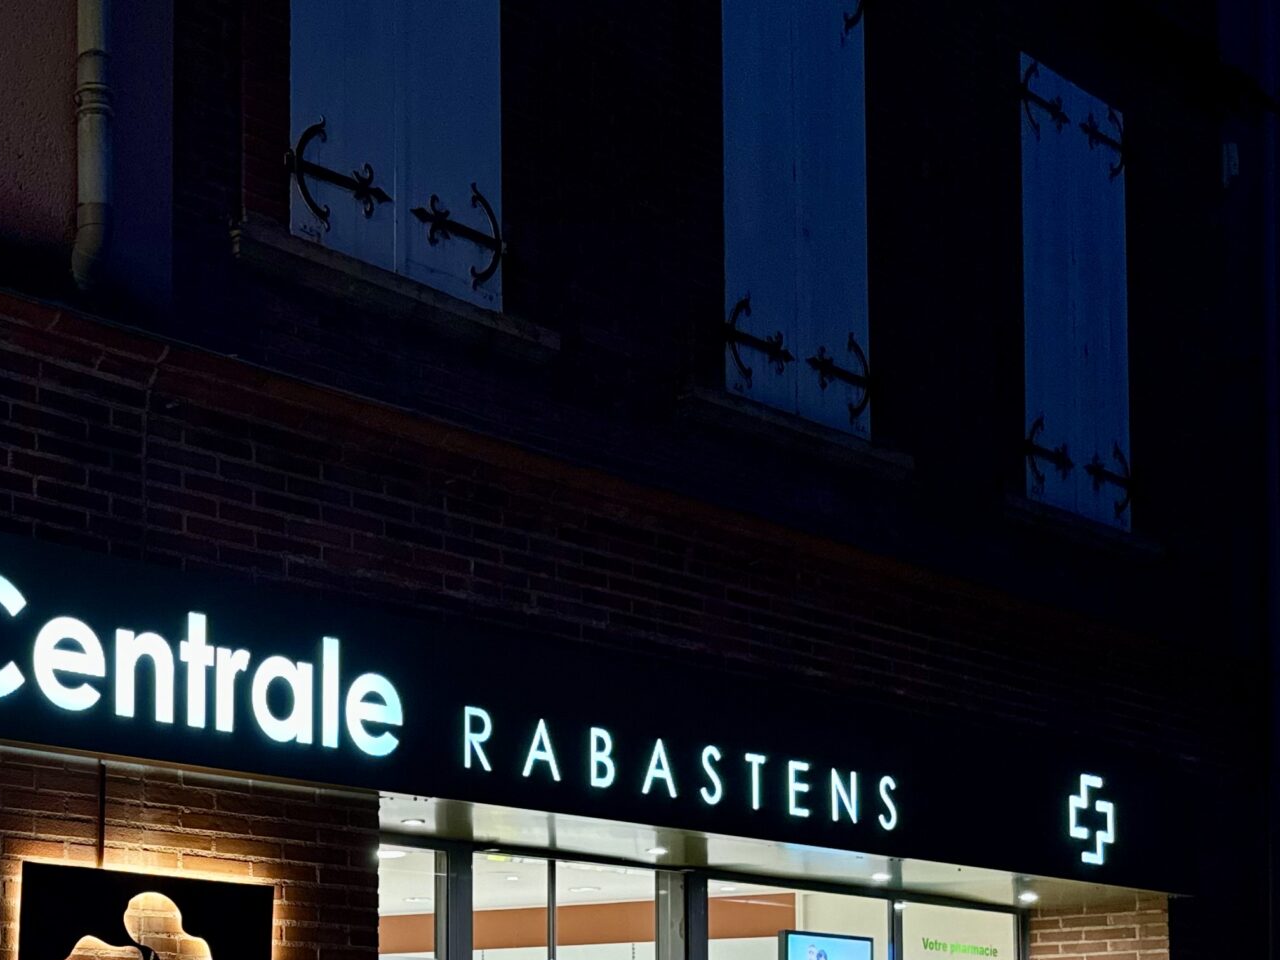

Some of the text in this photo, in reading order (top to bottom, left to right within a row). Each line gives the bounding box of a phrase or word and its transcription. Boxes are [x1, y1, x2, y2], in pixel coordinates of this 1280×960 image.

[463, 705, 901, 832] RABASTENS
[922, 937, 998, 957] Votre pharmacie
